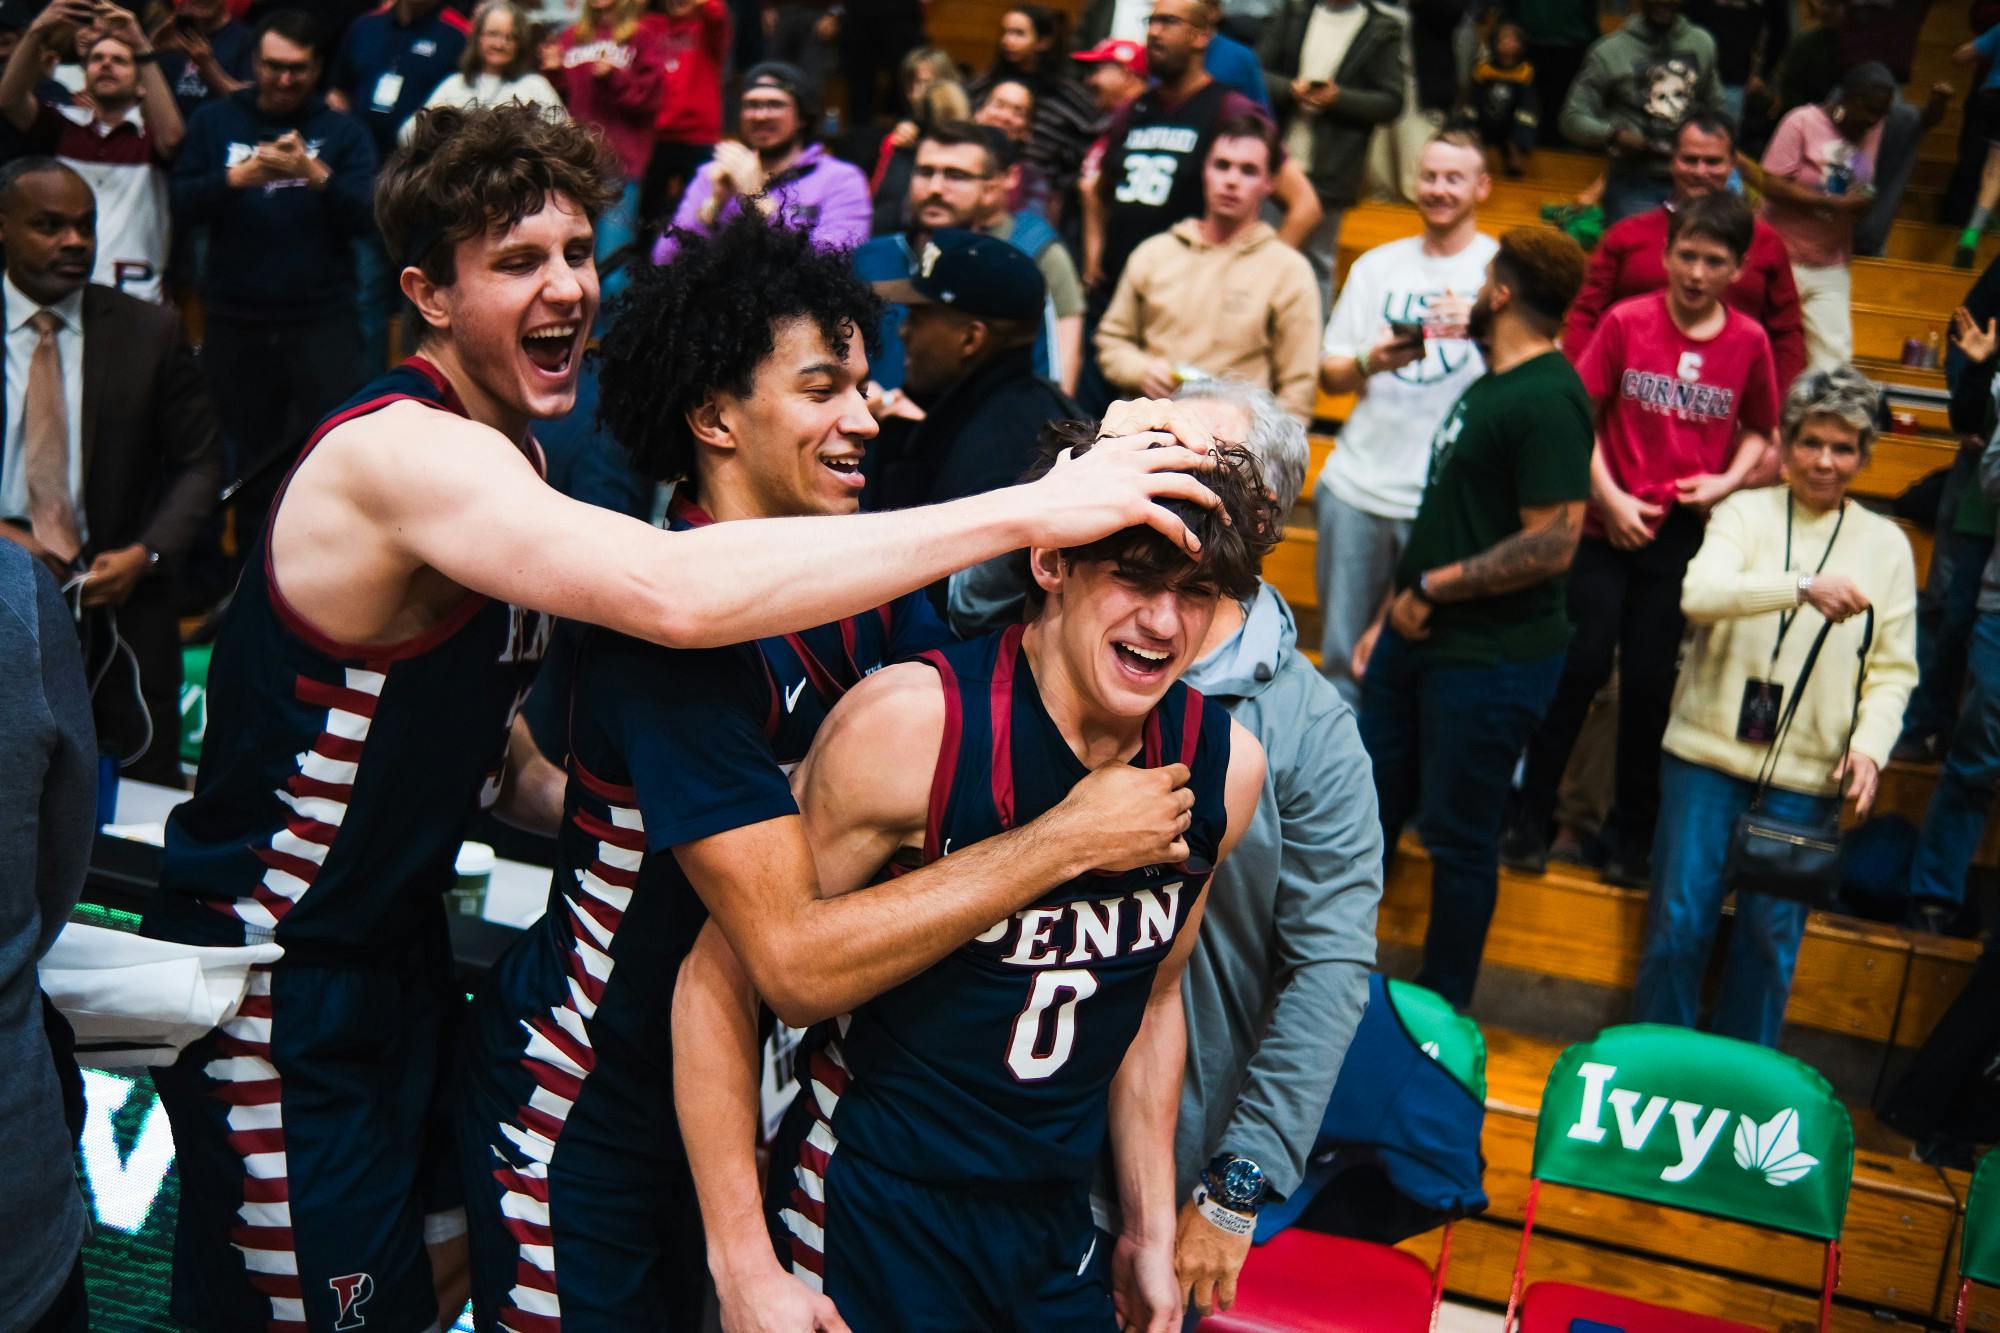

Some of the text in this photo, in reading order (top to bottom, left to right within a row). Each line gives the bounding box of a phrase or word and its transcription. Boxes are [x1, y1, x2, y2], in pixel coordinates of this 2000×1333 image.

[1115, 153, 1178, 206] 36
[1620, 368, 1735, 419] CORNELL
[1676, 351, 1703, 383] C
[973, 880, 1185, 966] ENN
[1003, 967, 1100, 1083] 0
[1567, 1062, 1731, 1182] Ivy
[329, 1272, 374, 1331] P
